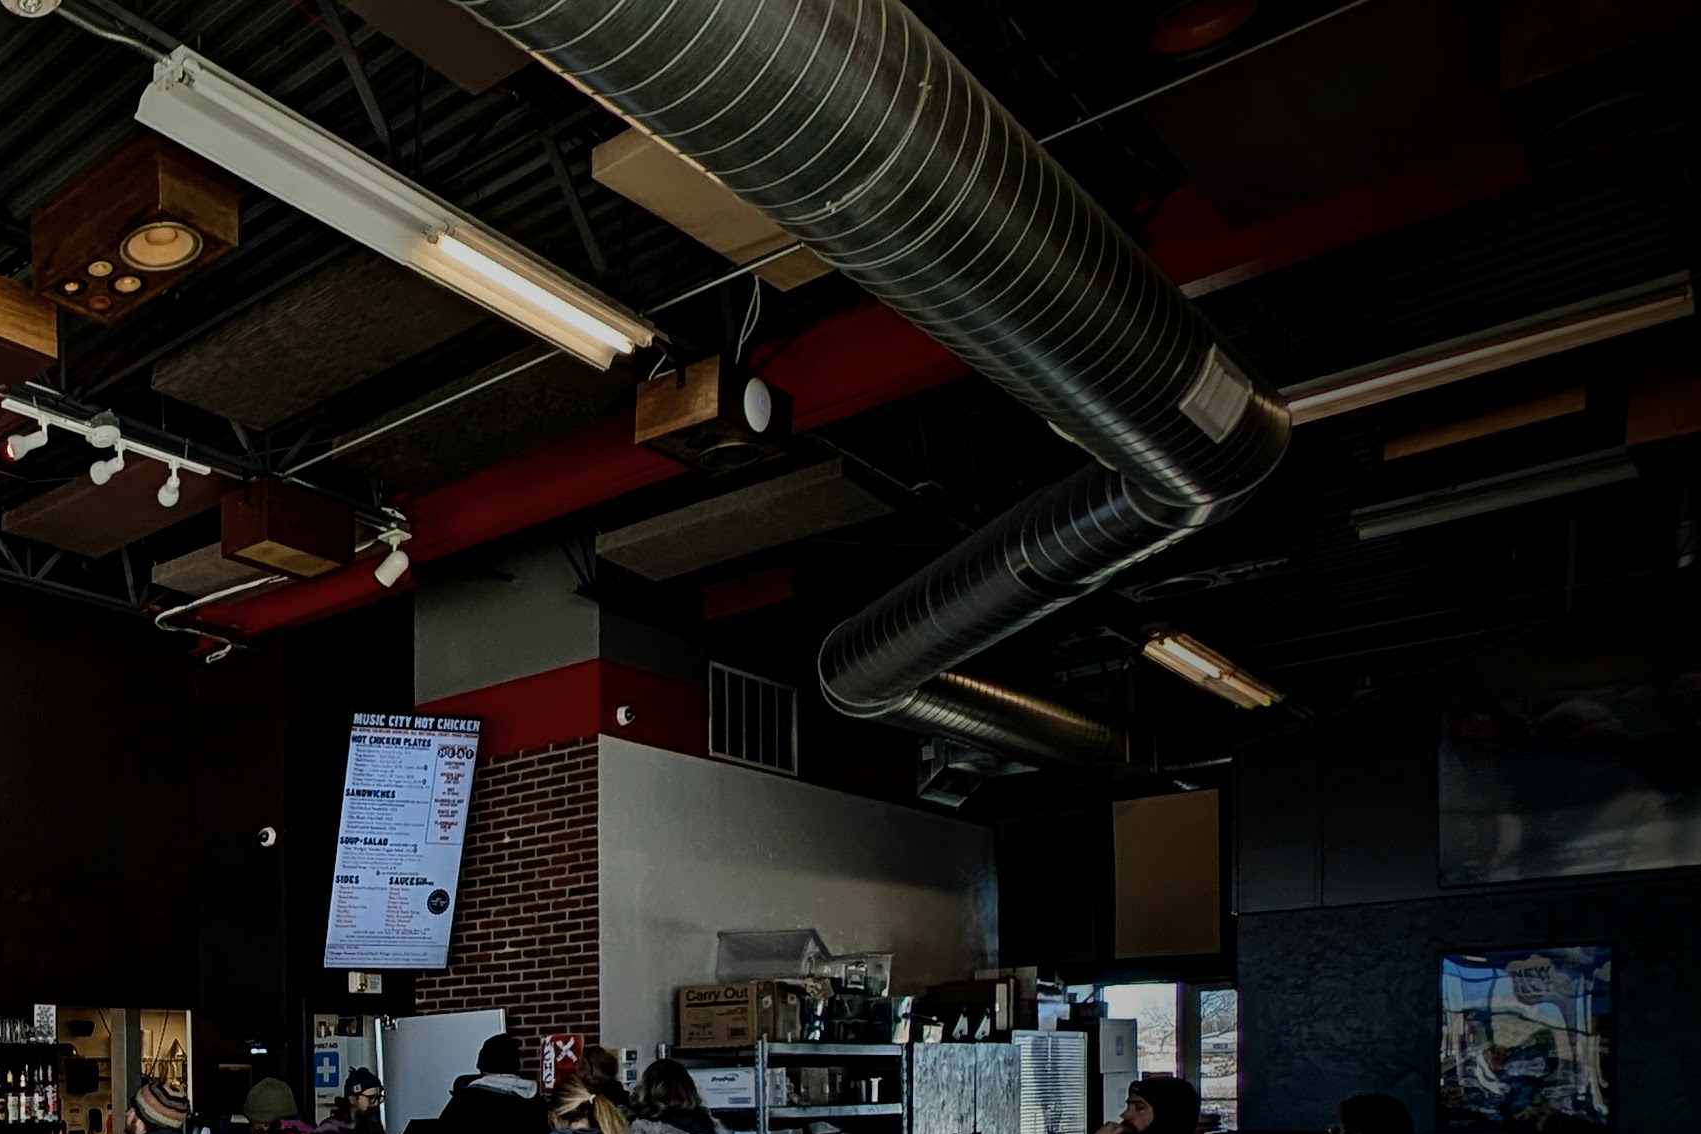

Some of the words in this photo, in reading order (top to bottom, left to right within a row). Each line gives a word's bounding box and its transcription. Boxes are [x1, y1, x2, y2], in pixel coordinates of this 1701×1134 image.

[354, 713, 386, 726] MUSIC
[388, 715, 412, 727] CITY
[414, 716, 435, 729] HOT
[437, 718, 480, 732] CHICKEN
[352, 735, 367, 744] HOT
[369, 736, 402, 746] CHICKEN
[404, 738, 432, 747] PLATES
[346, 788, 396, 798] SANDWICHES
[336, 875, 359, 884] SIDES
[685, 989, 720, 1002] Carry
[724, 987, 748, 999] Out
